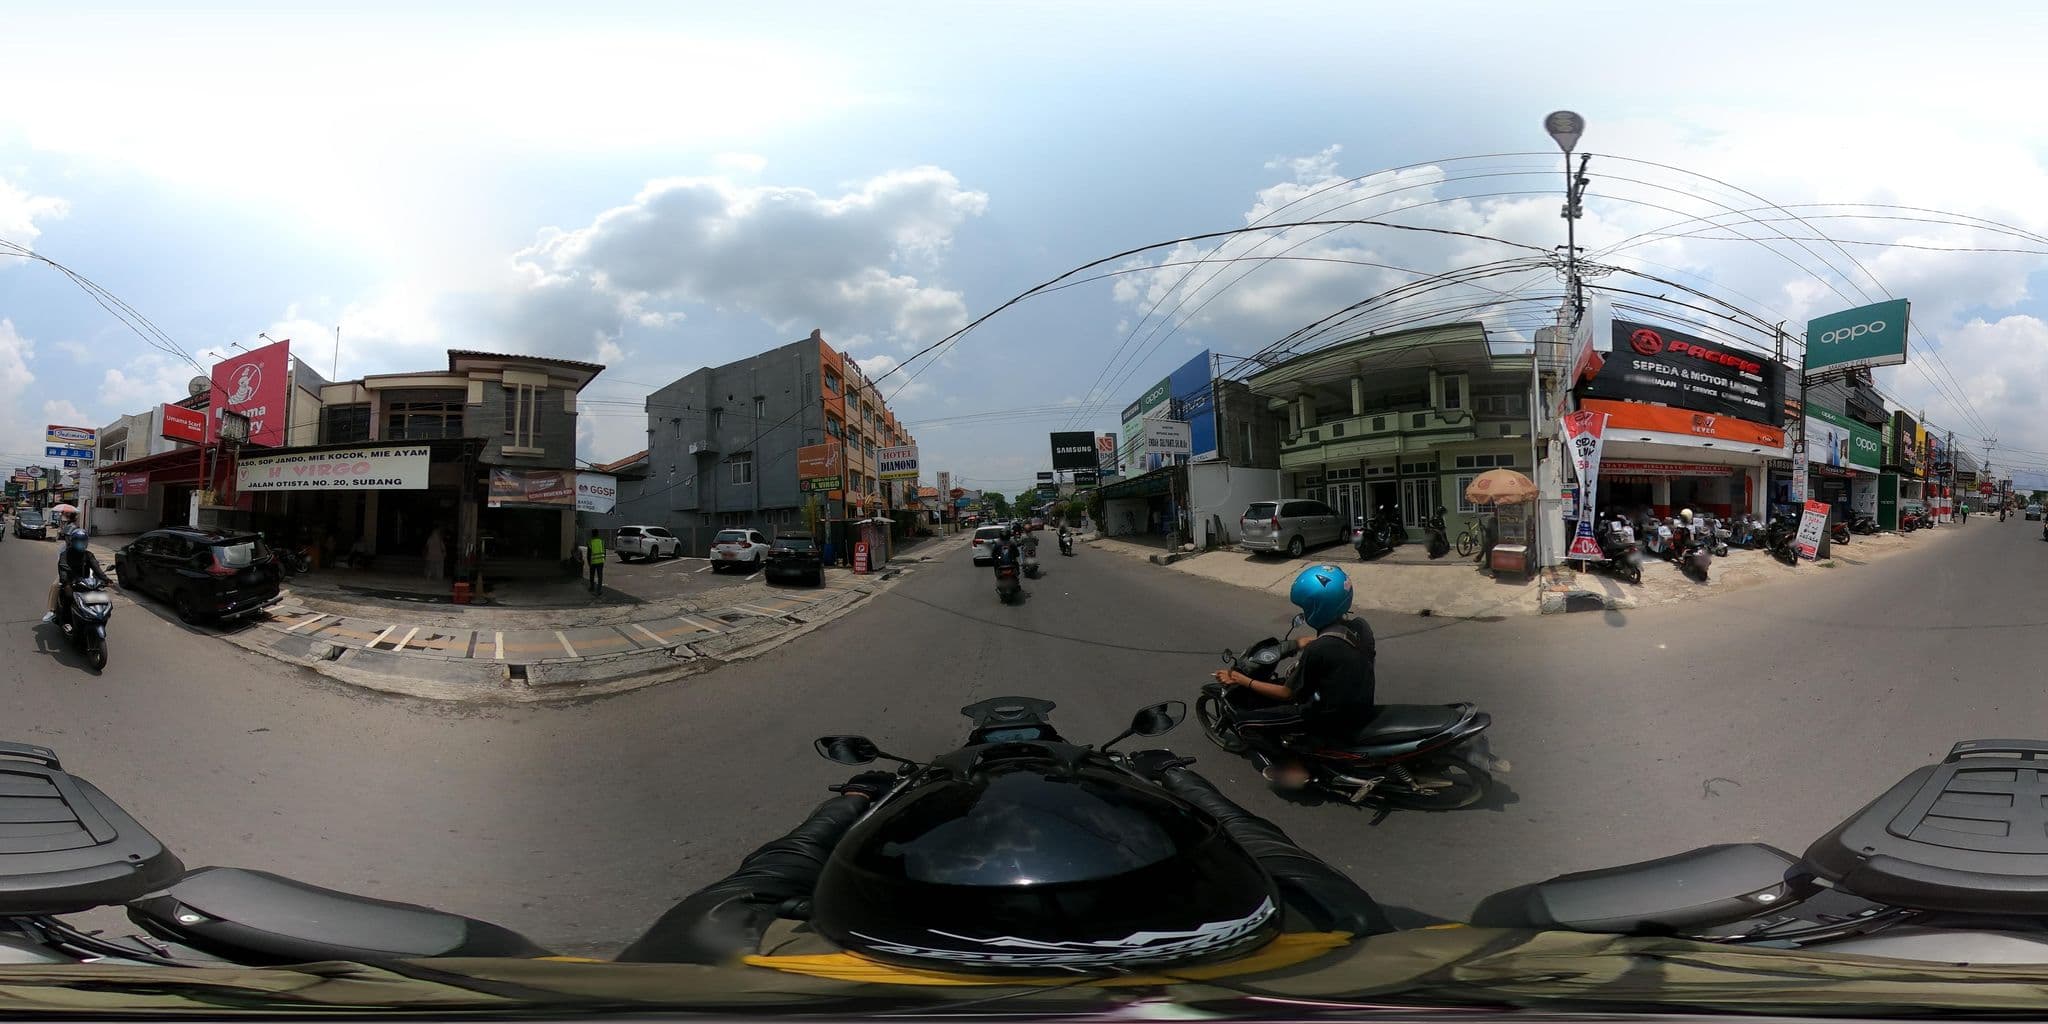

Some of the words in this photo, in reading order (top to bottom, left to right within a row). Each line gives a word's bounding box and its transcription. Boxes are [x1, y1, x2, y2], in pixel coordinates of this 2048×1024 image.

[1668, 340, 1761, 374] PACIFIC
[1632, 360, 1680, 376] SEPEDA
[1680, 368, 1690, 380] &
[1690, 370, 1728, 388] MOTOR
[258, 458, 273, 466] SOP
[275, 456, 306, 464] JANDO,
[328, 452, 367, 460] KOCOK,
[883, 450, 912, 459] HOTEL
[269, 466, 282, 478] H
[293, 462, 371, 476] VIRGO
[881, 460, 917, 472] DIAMOND
[590, 486, 615, 497] GGSP
